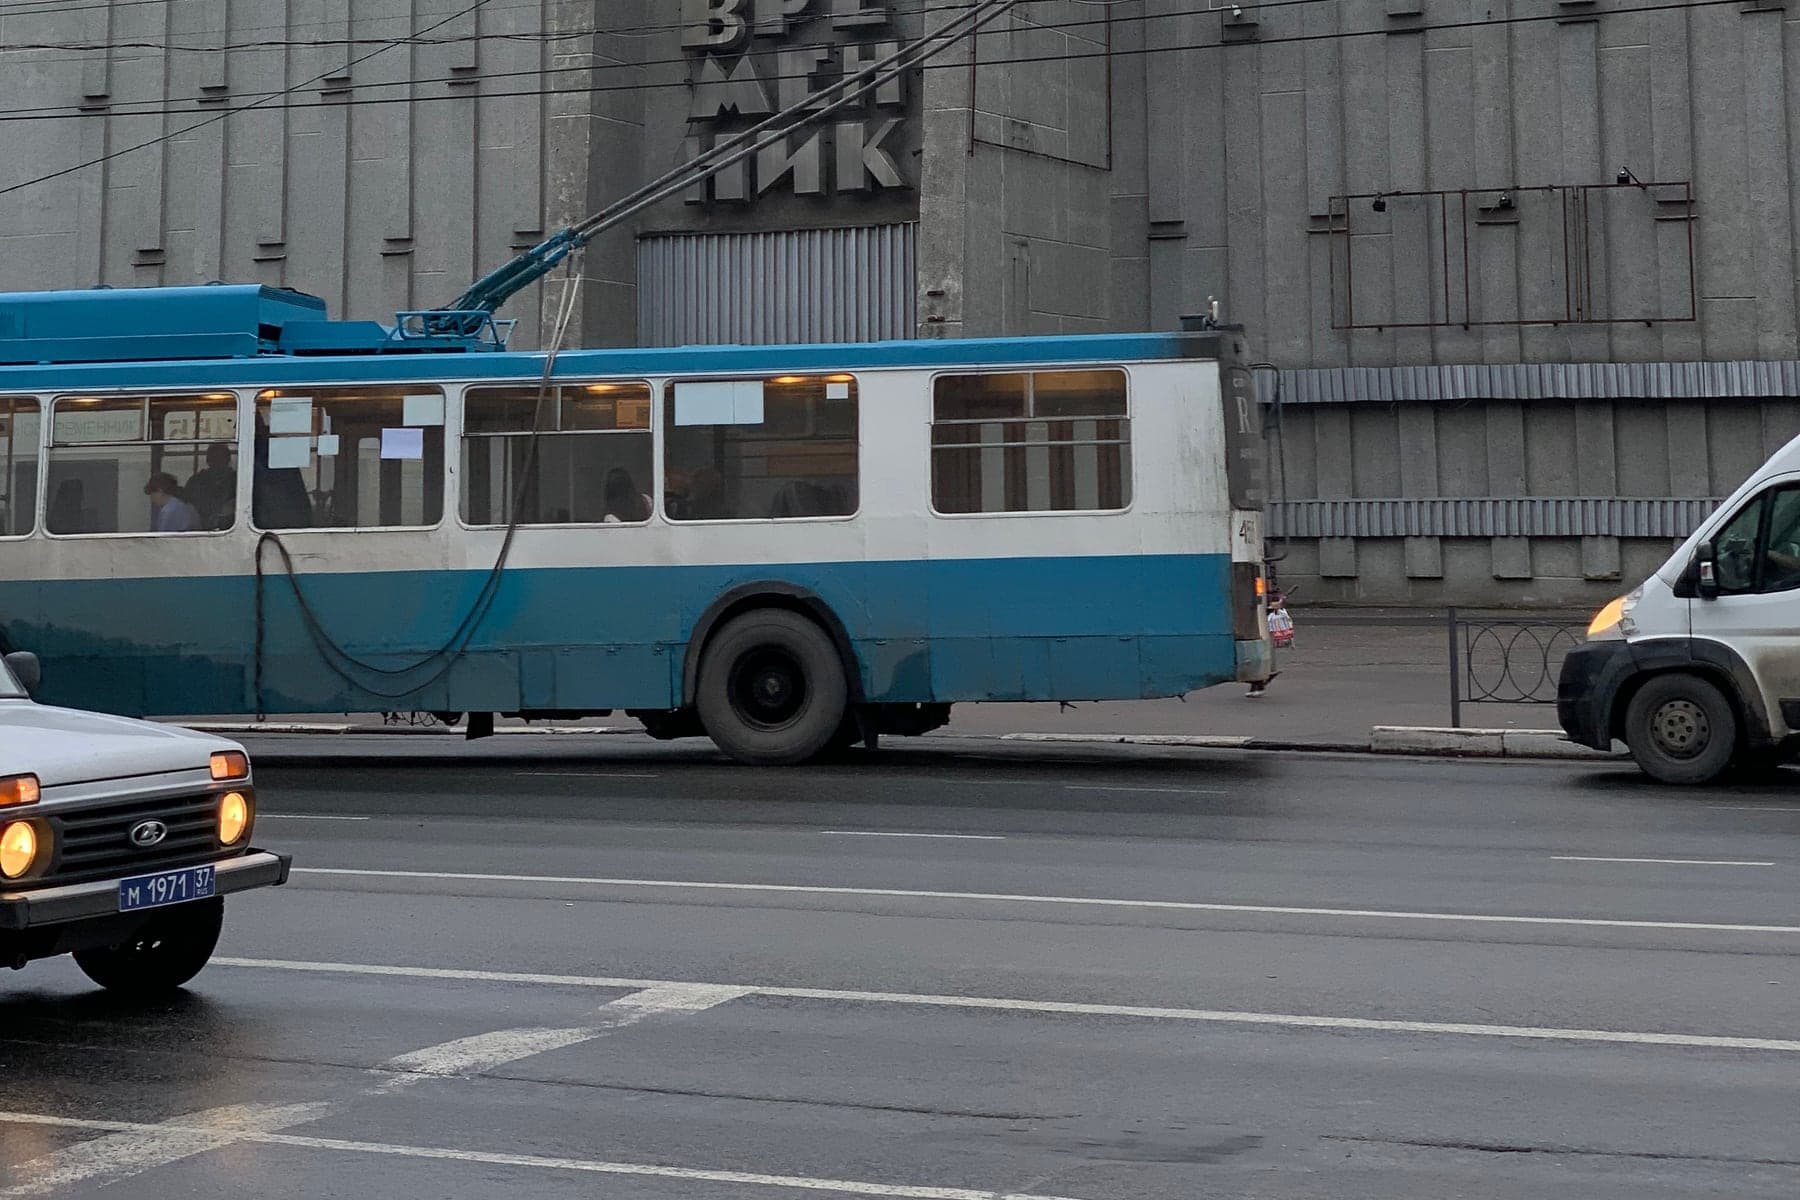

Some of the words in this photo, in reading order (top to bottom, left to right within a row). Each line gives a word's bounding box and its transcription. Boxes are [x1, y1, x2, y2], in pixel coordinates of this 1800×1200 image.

[686, 42, 905, 122] МЕН
[683, 118, 908, 204] НИК
[128, 886, 140, 906] М
[147, 873, 186, 902] 1971
[196, 868, 210, 887] 37
